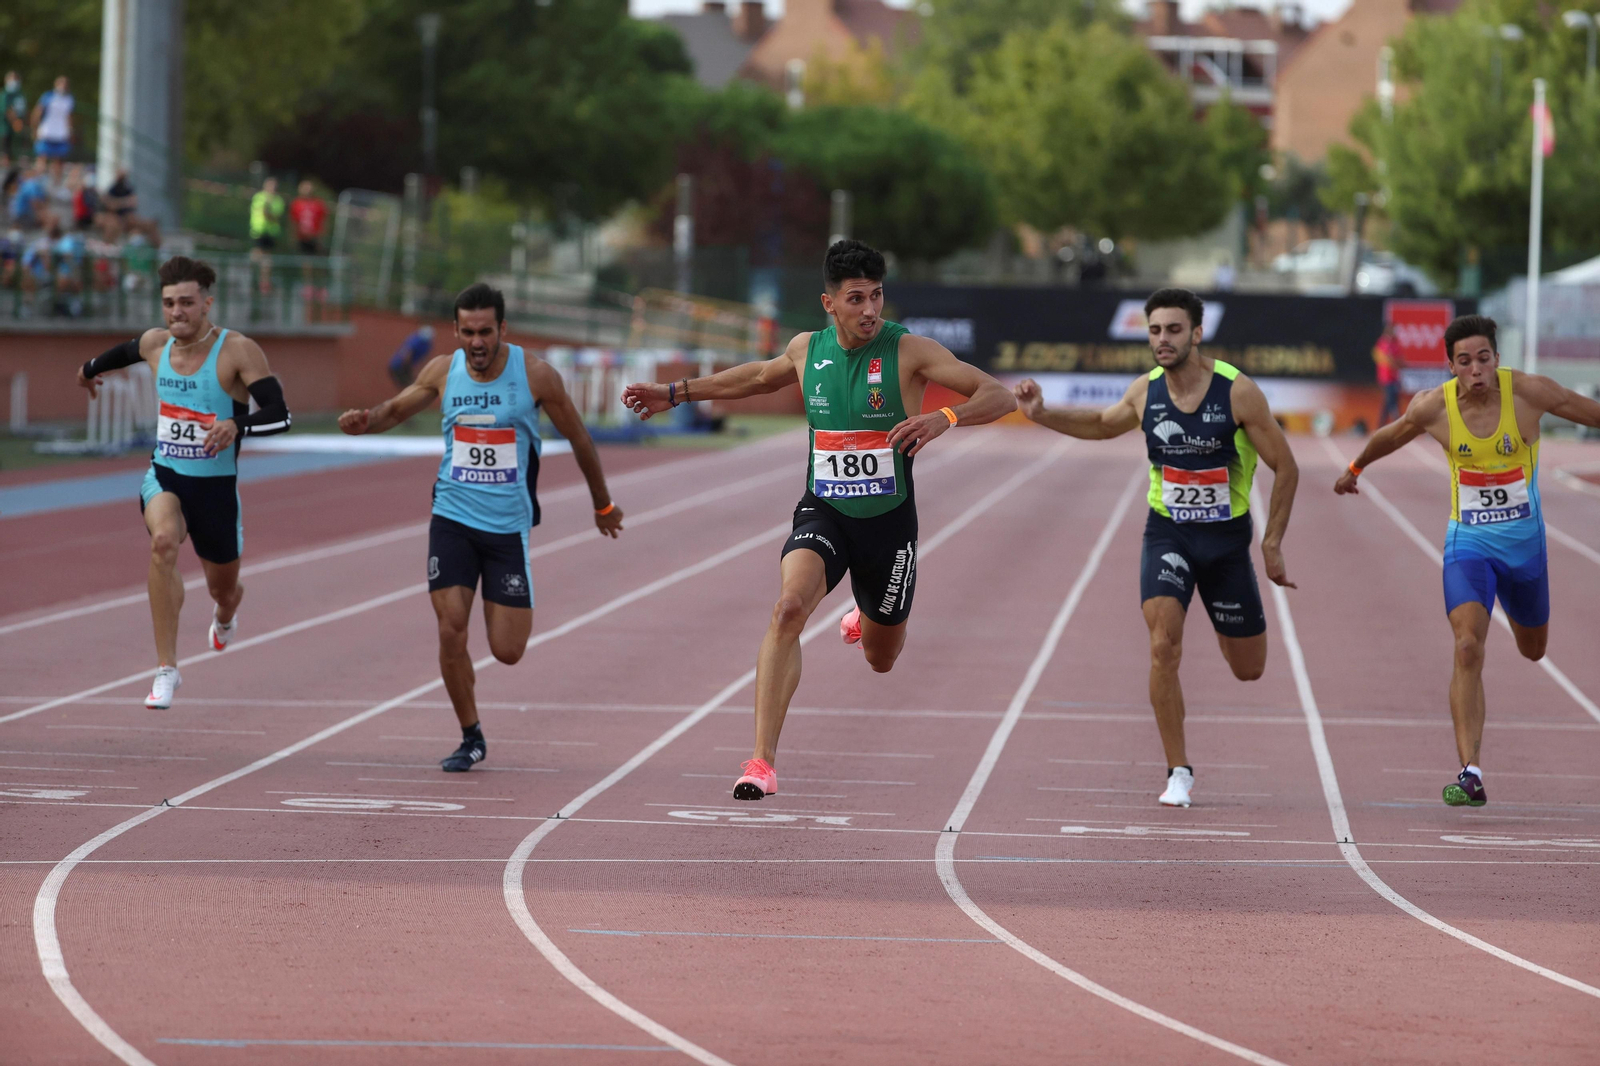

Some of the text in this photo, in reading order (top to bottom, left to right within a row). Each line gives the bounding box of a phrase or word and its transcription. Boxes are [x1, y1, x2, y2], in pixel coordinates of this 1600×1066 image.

[159, 377, 198, 392] nerja
[452, 391, 502, 409] nerja
[170, 422, 196, 442] 94
[1182, 434, 1222, 449] Unicaja
[469, 447, 497, 467] 98
[826, 453, 878, 478] 180
[1173, 487, 1217, 505] 223
[1479, 488, 1509, 508] 59
[878, 549, 908, 616] PLAYAS DE CASTELLON
